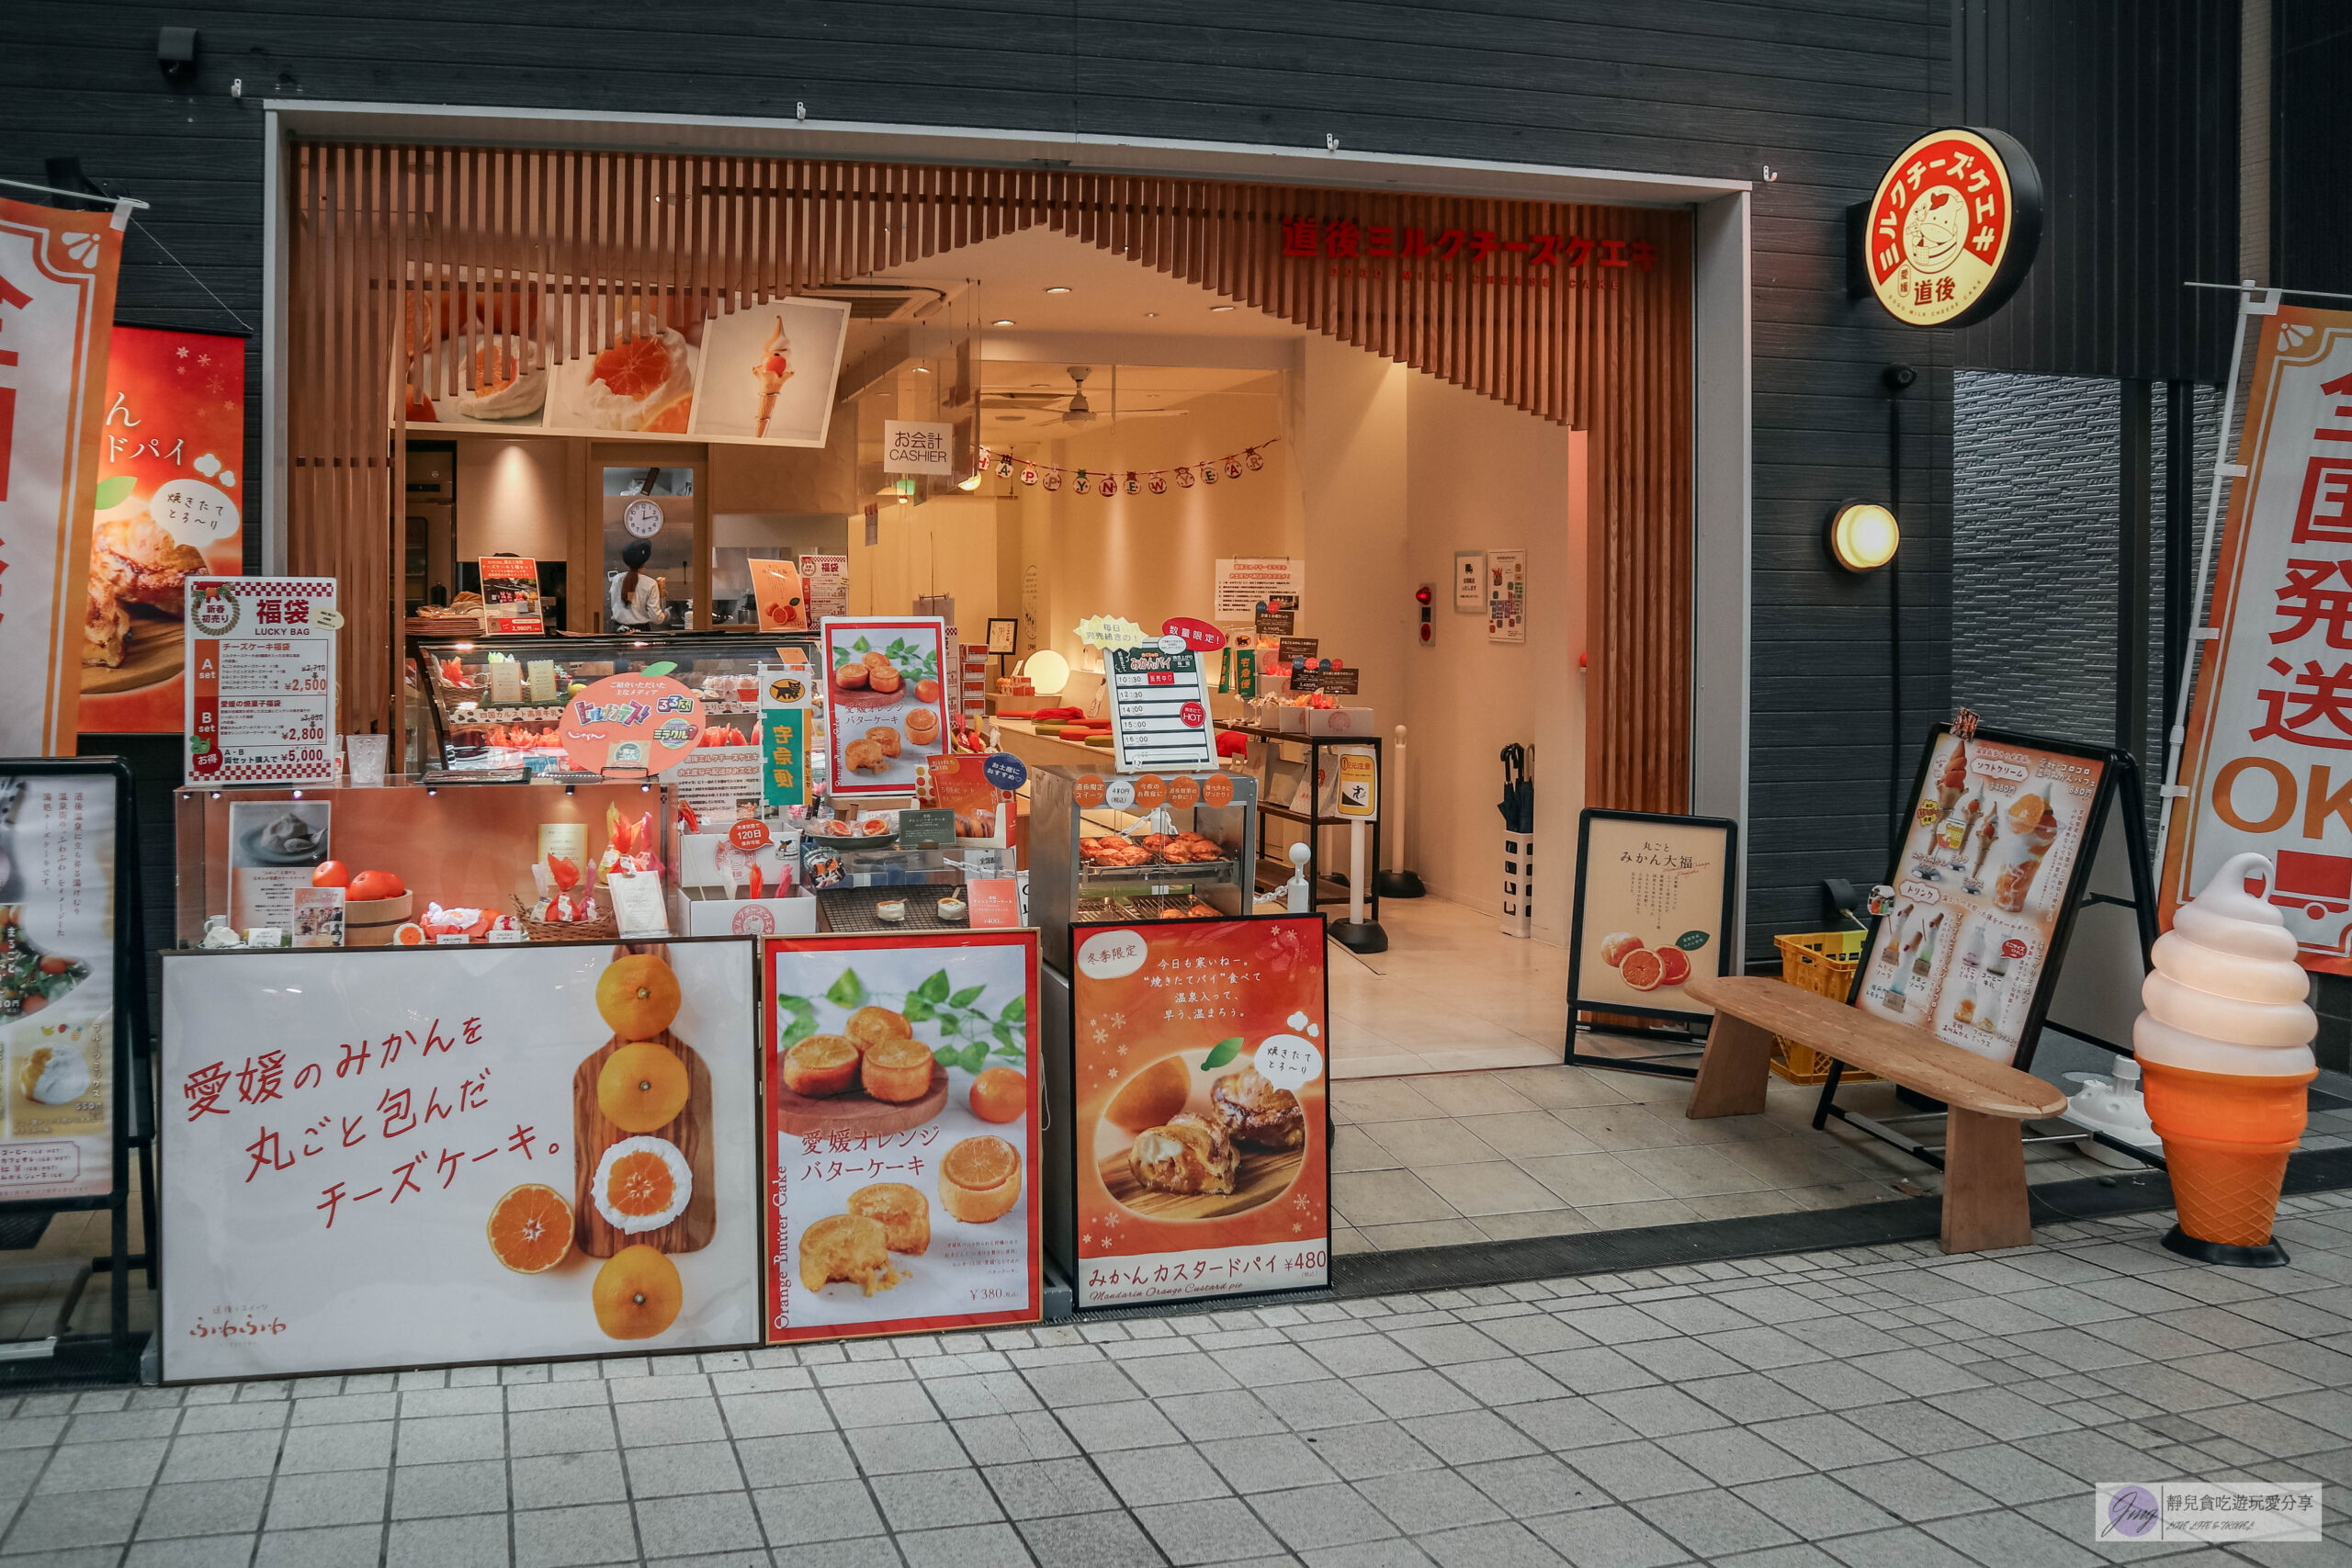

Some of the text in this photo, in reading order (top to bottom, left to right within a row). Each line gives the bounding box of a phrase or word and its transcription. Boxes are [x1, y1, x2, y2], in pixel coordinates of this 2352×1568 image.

[1879, 151, 1996, 271] ミルクチーズケエキ
[1283, 218, 1658, 270] 道後ミルクチーズケエキ
[1914, 276, 1956, 306] 道後
[895, 431, 943, 449] お会計
[888, 448, 947, 463] CASHIER
[167, 492, 223, 516] 焼きたて
[821, 563, 839, 572] 福袋
[207, 604, 225, 614] 新春
[256, 599, 310, 625] 福袋
[201, 615, 229, 624] 初売り
[254, 627, 310, 636] LUCKY BAG
[1103, 624, 1120, 632] 毎日
[1169, 625, 1220, 645] 数量限定!
[222, 643, 290, 651] チーズケーキ福袋
[201, 658, 213, 671] A
[1130, 657, 1171, 671] みかんパイ
[198, 671, 216, 679] set
[284, 678, 327, 693] ¥2,500
[657, 695, 695, 714] るるぶ
[201, 712, 212, 724] B
[845, 716, 899, 725] バターケーキ
[1183, 713, 1202, 721] HOT
[198, 725, 216, 733] set
[281, 728, 324, 741] ¥2,800
[653, 725, 698, 740] ミラクル9
[198, 753, 218, 765] お得
[224, 756, 277, 764] 両セット購入で
[280, 749, 323, 763] ¥5,000
[987, 768, 1015, 781] おすすめ
[991, 762, 1021, 774] お土産に
[1977, 761, 2024, 778] ソフトクリーム
[2211, 756, 2352, 840] OK
[737, 829, 762, 840] 120日
[1643, 841, 1669, 852] 丸ごと
[1620, 852, 1693, 869] みかん大福
[1087, 944, 1137, 966] 冬季限定
[1158, 956, 1250, 971] 今日も寒いねー。
[1982, 973, 2001, 982] コーヒー
[1174, 989, 1240, 1004] 温泉入って、
[1267, 1045, 1312, 1063] 焼きたて
[184, 1017, 482, 1122] 愛媛のみかんを
[245, 1066, 492, 1183] 丸ごと包んだ
[800, 1125, 940, 1156] 愛媛オレンジ
[800, 1155, 925, 1182] バターケーキ
[316, 1124, 560, 1229] チーズケーキ。
[772, 1166, 791, 1330] Orange Butter Cake
[1284, 1250, 1327, 1272] ¥480
[1089, 1289, 1142, 1302] Mandarin
[1146, 1285, 1183, 1297] Orange
[1184, 1282, 1227, 1293] Custard
